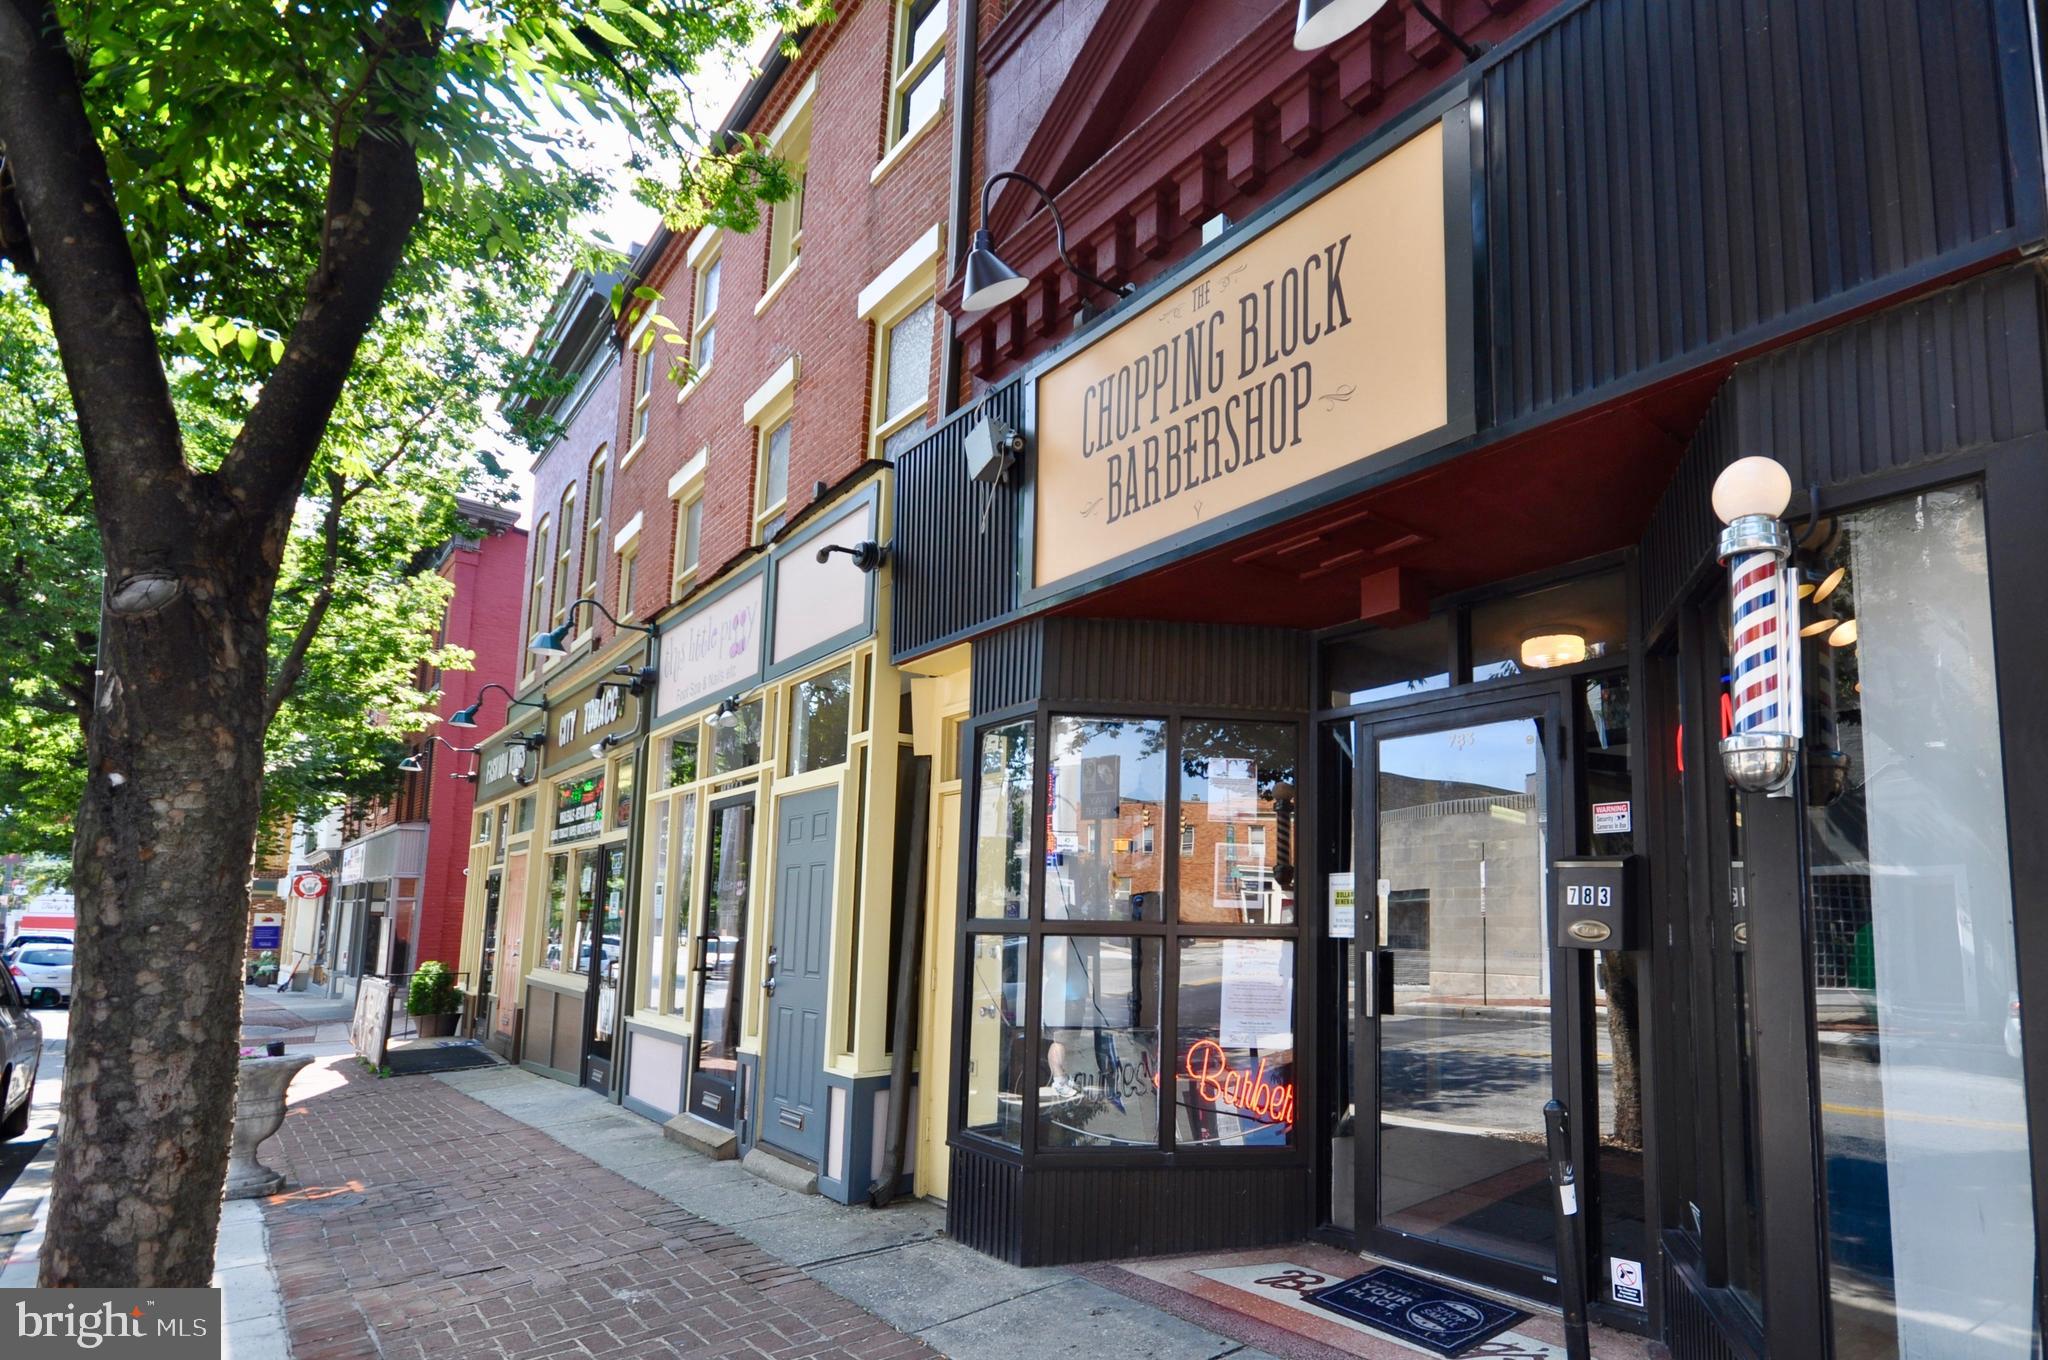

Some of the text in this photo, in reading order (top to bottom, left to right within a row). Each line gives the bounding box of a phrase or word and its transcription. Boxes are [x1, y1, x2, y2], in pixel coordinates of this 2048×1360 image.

[1191, 279, 1211, 313] THE
[1082, 234, 1352, 459] CHOPPING BLOCK
[1106, 361, 1313, 525] BARBERSHOP
[1596, 804, 1628, 813] WARNING
[1569, 887, 1608, 905] 783
[1344, 1287, 1402, 1311] PLACE
[1361, 1282, 1413, 1305] YOUR
[1420, 1308, 1459, 1328] SMALL
[1433, 1306, 1468, 1323] SHOP
